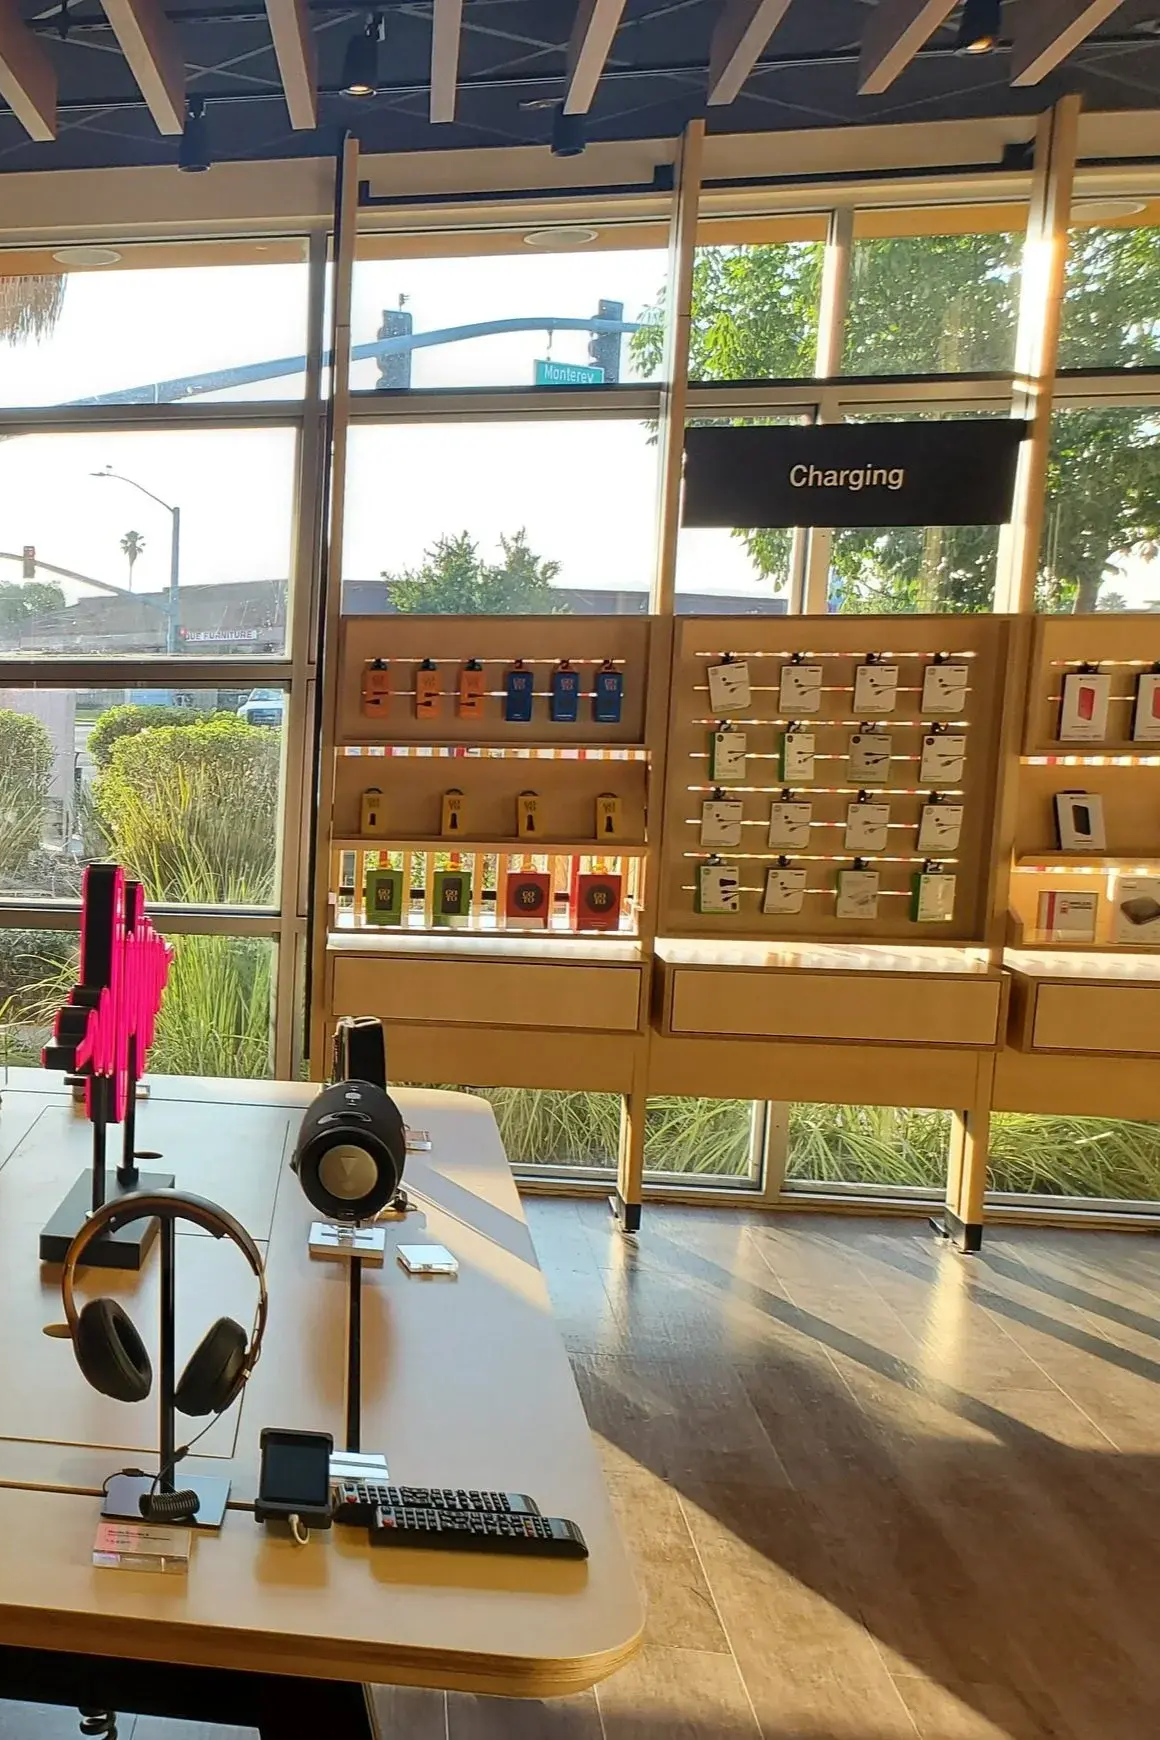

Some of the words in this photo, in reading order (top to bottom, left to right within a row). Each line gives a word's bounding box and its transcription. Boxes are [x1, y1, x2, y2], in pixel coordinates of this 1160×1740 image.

[544, 364, 594, 383] Monterey
[790, 463, 904, 491] Charging
[204, 630, 253, 640] FURNITURE
